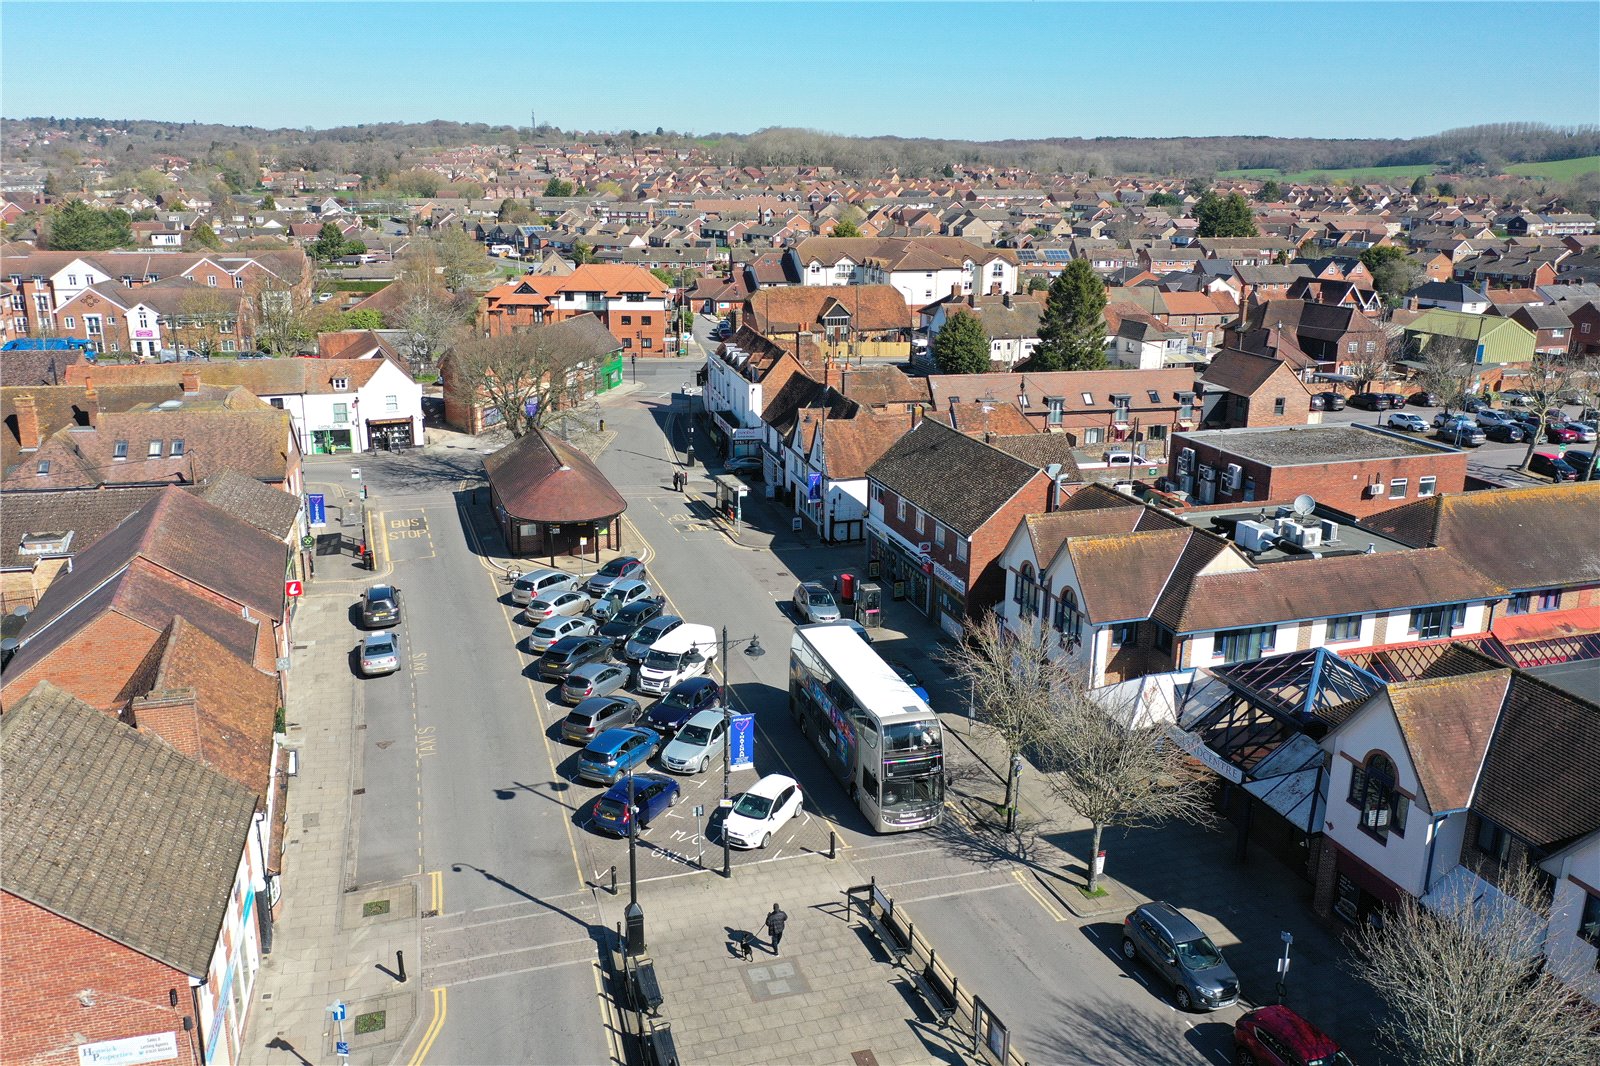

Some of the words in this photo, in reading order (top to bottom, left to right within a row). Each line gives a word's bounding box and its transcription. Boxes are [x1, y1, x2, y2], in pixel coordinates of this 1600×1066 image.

[391, 518, 420, 529] BUS
[388, 529, 427, 540] STOP
[412, 652, 429, 677] TAXIS
[417, 726, 438, 759] TAXIS
[670, 829, 706, 845] M/C
